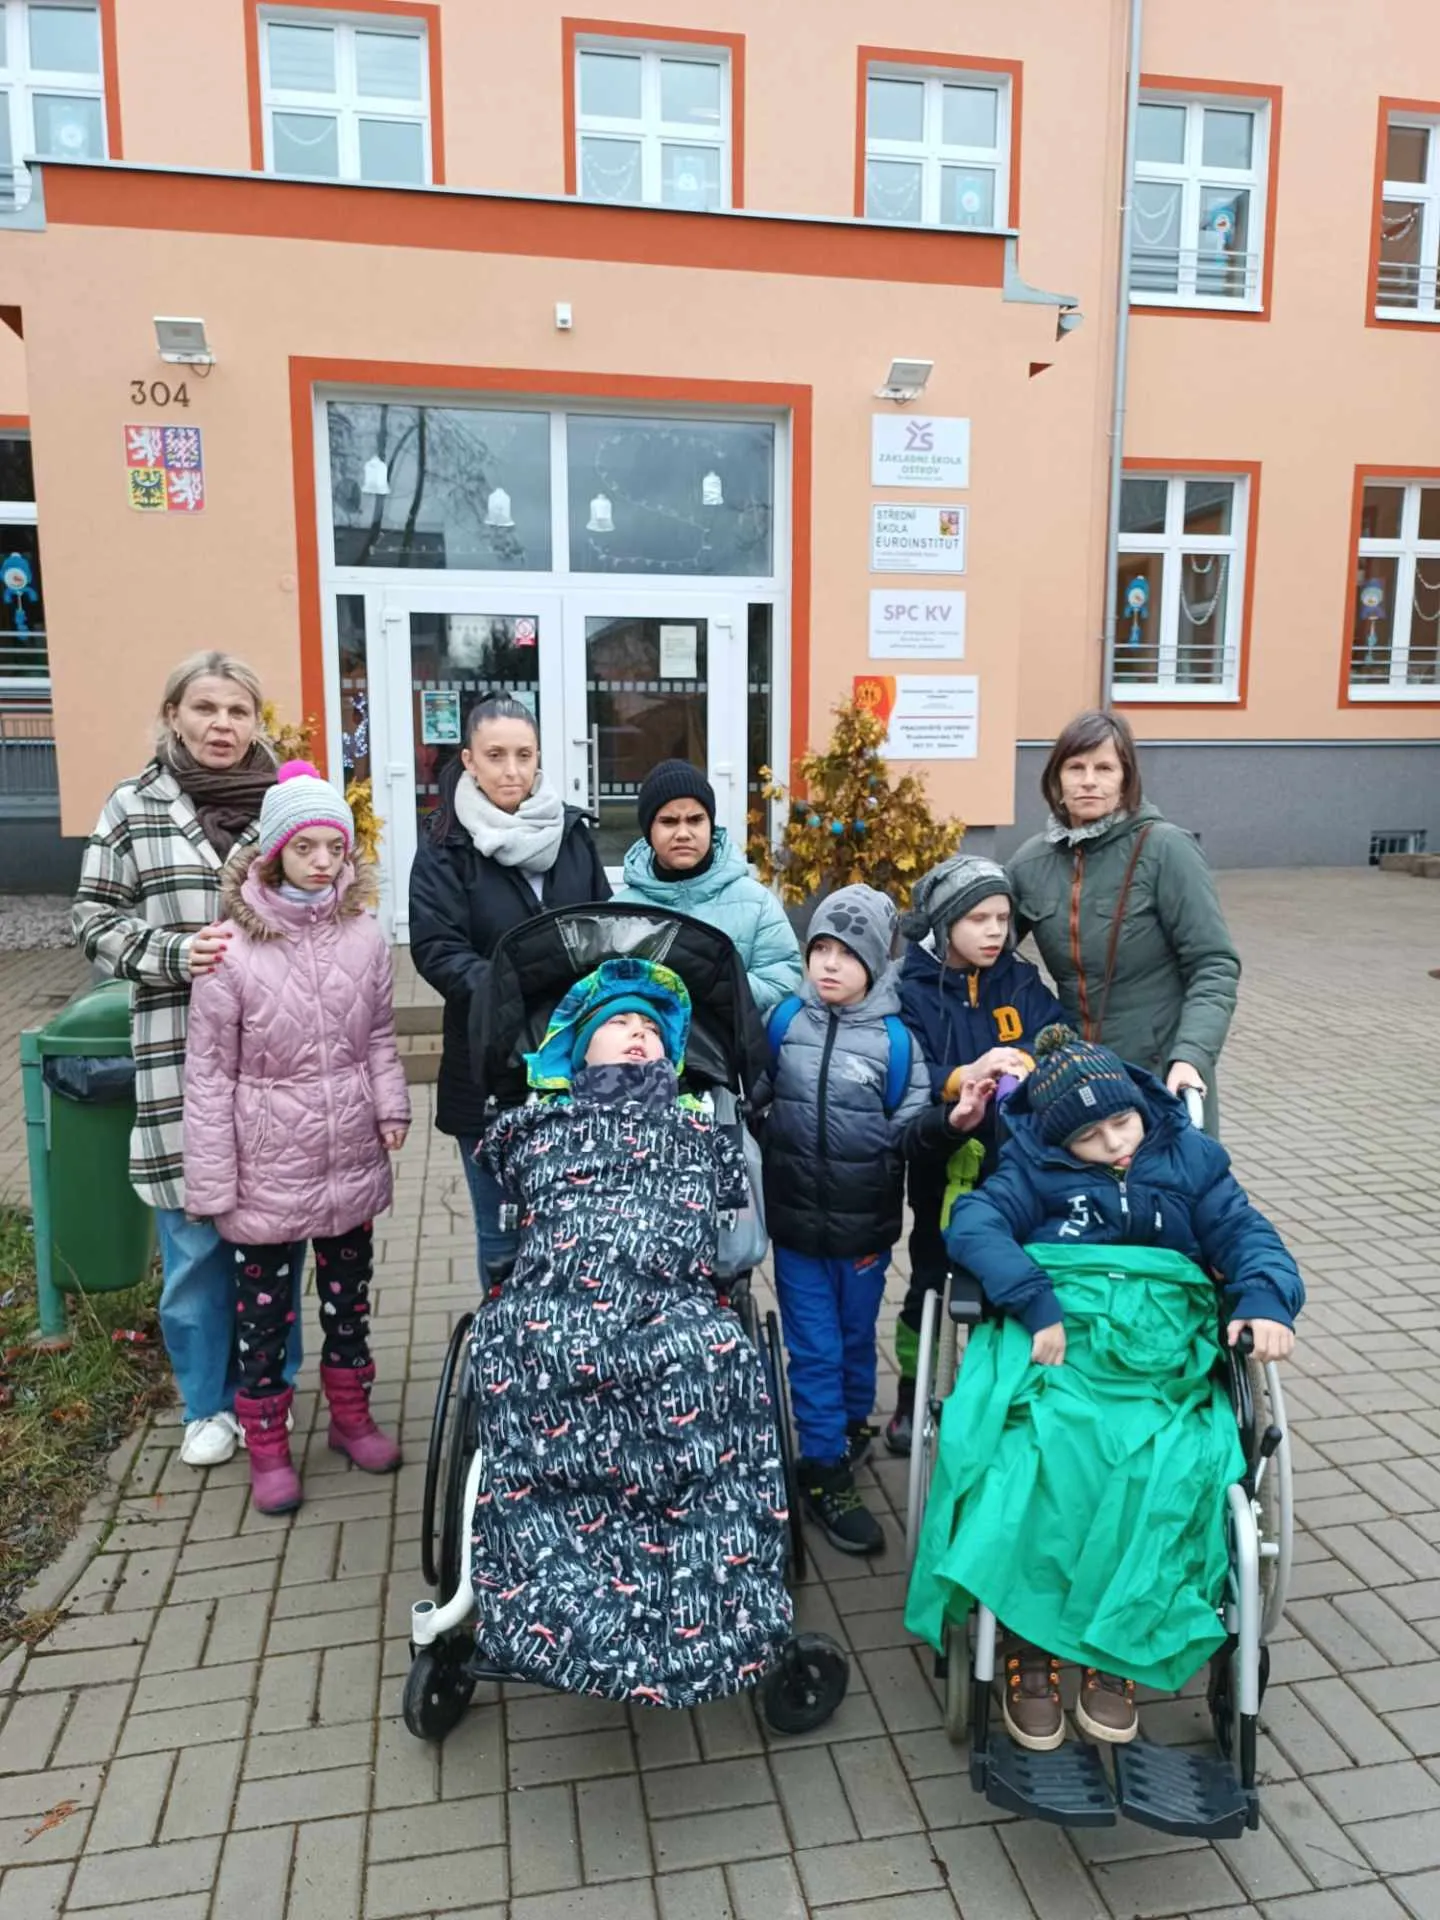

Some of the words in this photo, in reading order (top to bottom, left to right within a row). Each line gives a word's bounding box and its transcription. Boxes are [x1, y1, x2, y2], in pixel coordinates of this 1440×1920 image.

[130, 380, 191, 407] 304
[877, 508, 916, 520] STŘEDNÍ
[877, 522, 908, 533] ŠKOLA
[875, 536, 959, 550] EUROINSTITUT
[883, 604, 919, 621] SPC
[925, 605, 952, 622] KV
[991, 1006, 1024, 1043] D
